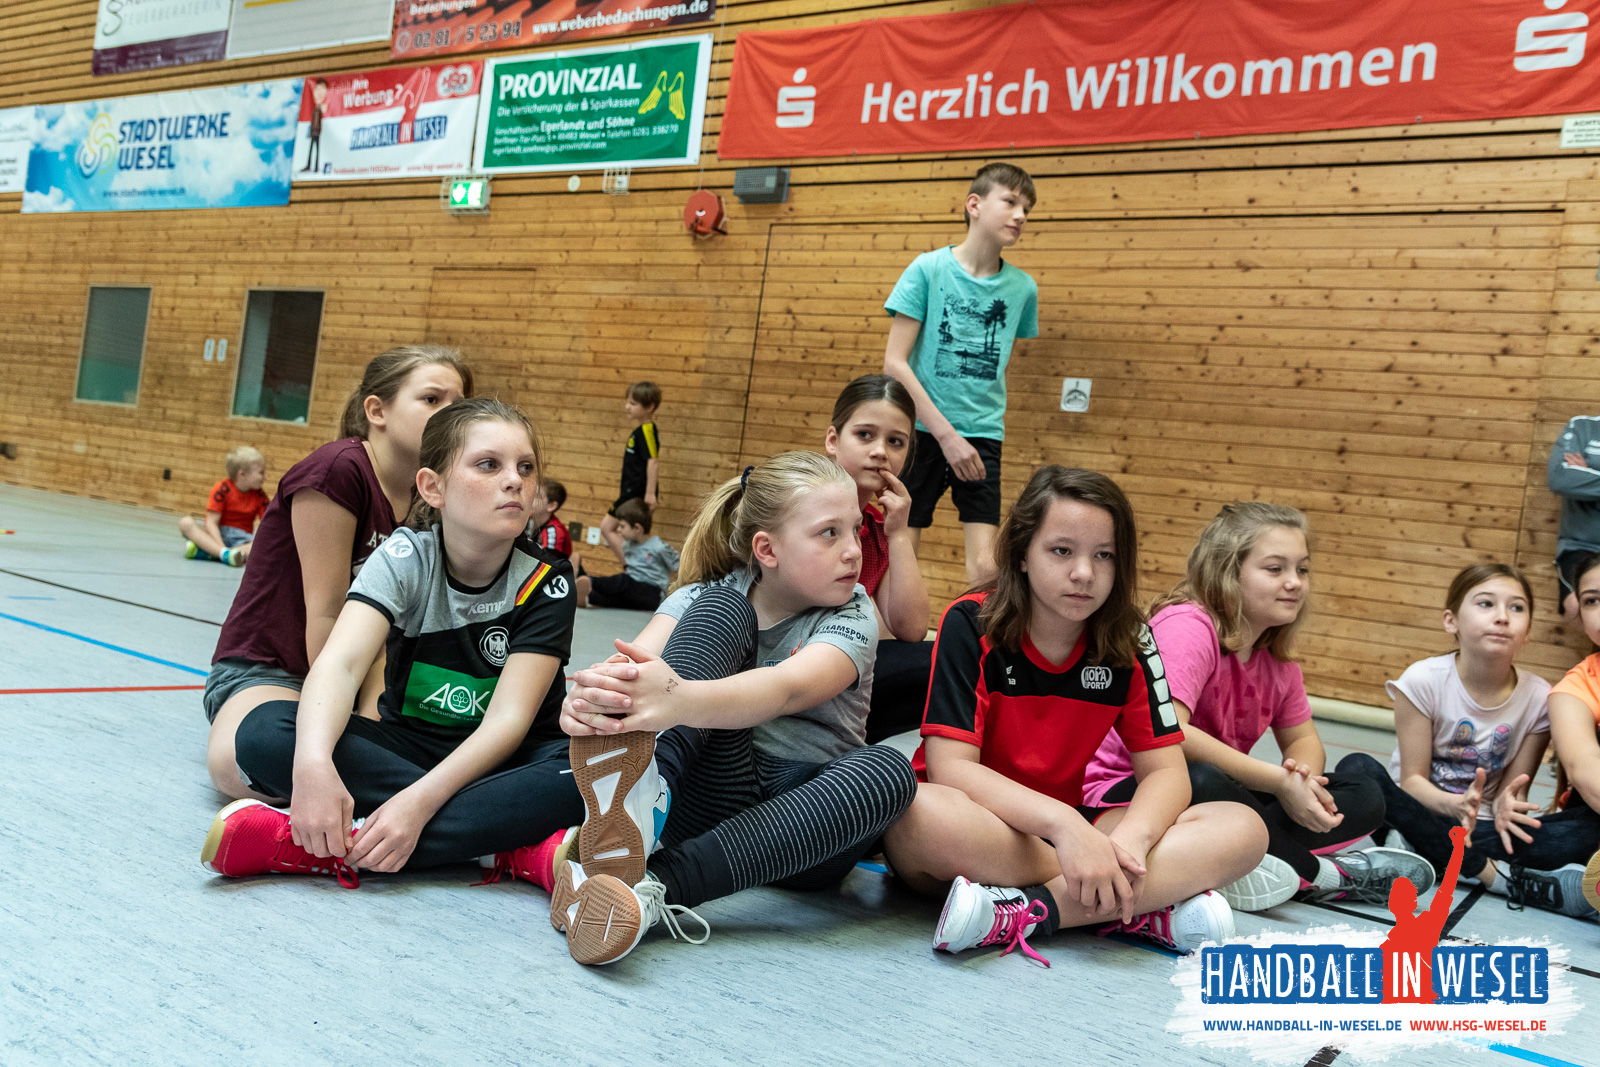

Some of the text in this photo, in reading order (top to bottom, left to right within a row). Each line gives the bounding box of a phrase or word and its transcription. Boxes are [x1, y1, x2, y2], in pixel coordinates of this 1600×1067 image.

[409, 0, 477, 15] Bedachungen
[532, 0, 709, 34] www.weberbedachungen.de
[414, 31, 431, 48] 02
[435, 28, 450, 47] 81
[465, 24, 476, 43] 5
[479, 22, 498, 41] 23
[502, 20, 521, 38] 94
[343, 83, 404, 108] Werbung?
[500, 63, 642, 100] PROVINZIAL
[861, 42, 1437, 124] Herzlich Willkommen
[497, 97, 640, 117] Die Versicherung der Sparkassen
[117, 112, 230, 144] STADTWERKE
[351, 116, 447, 149] HANDBALL IN WESEL
[587, 117, 605, 130] und
[606, 116, 635, 128] Söhne
[118, 146, 175, 170] WESEL
[422, 683, 490, 716] AOK
